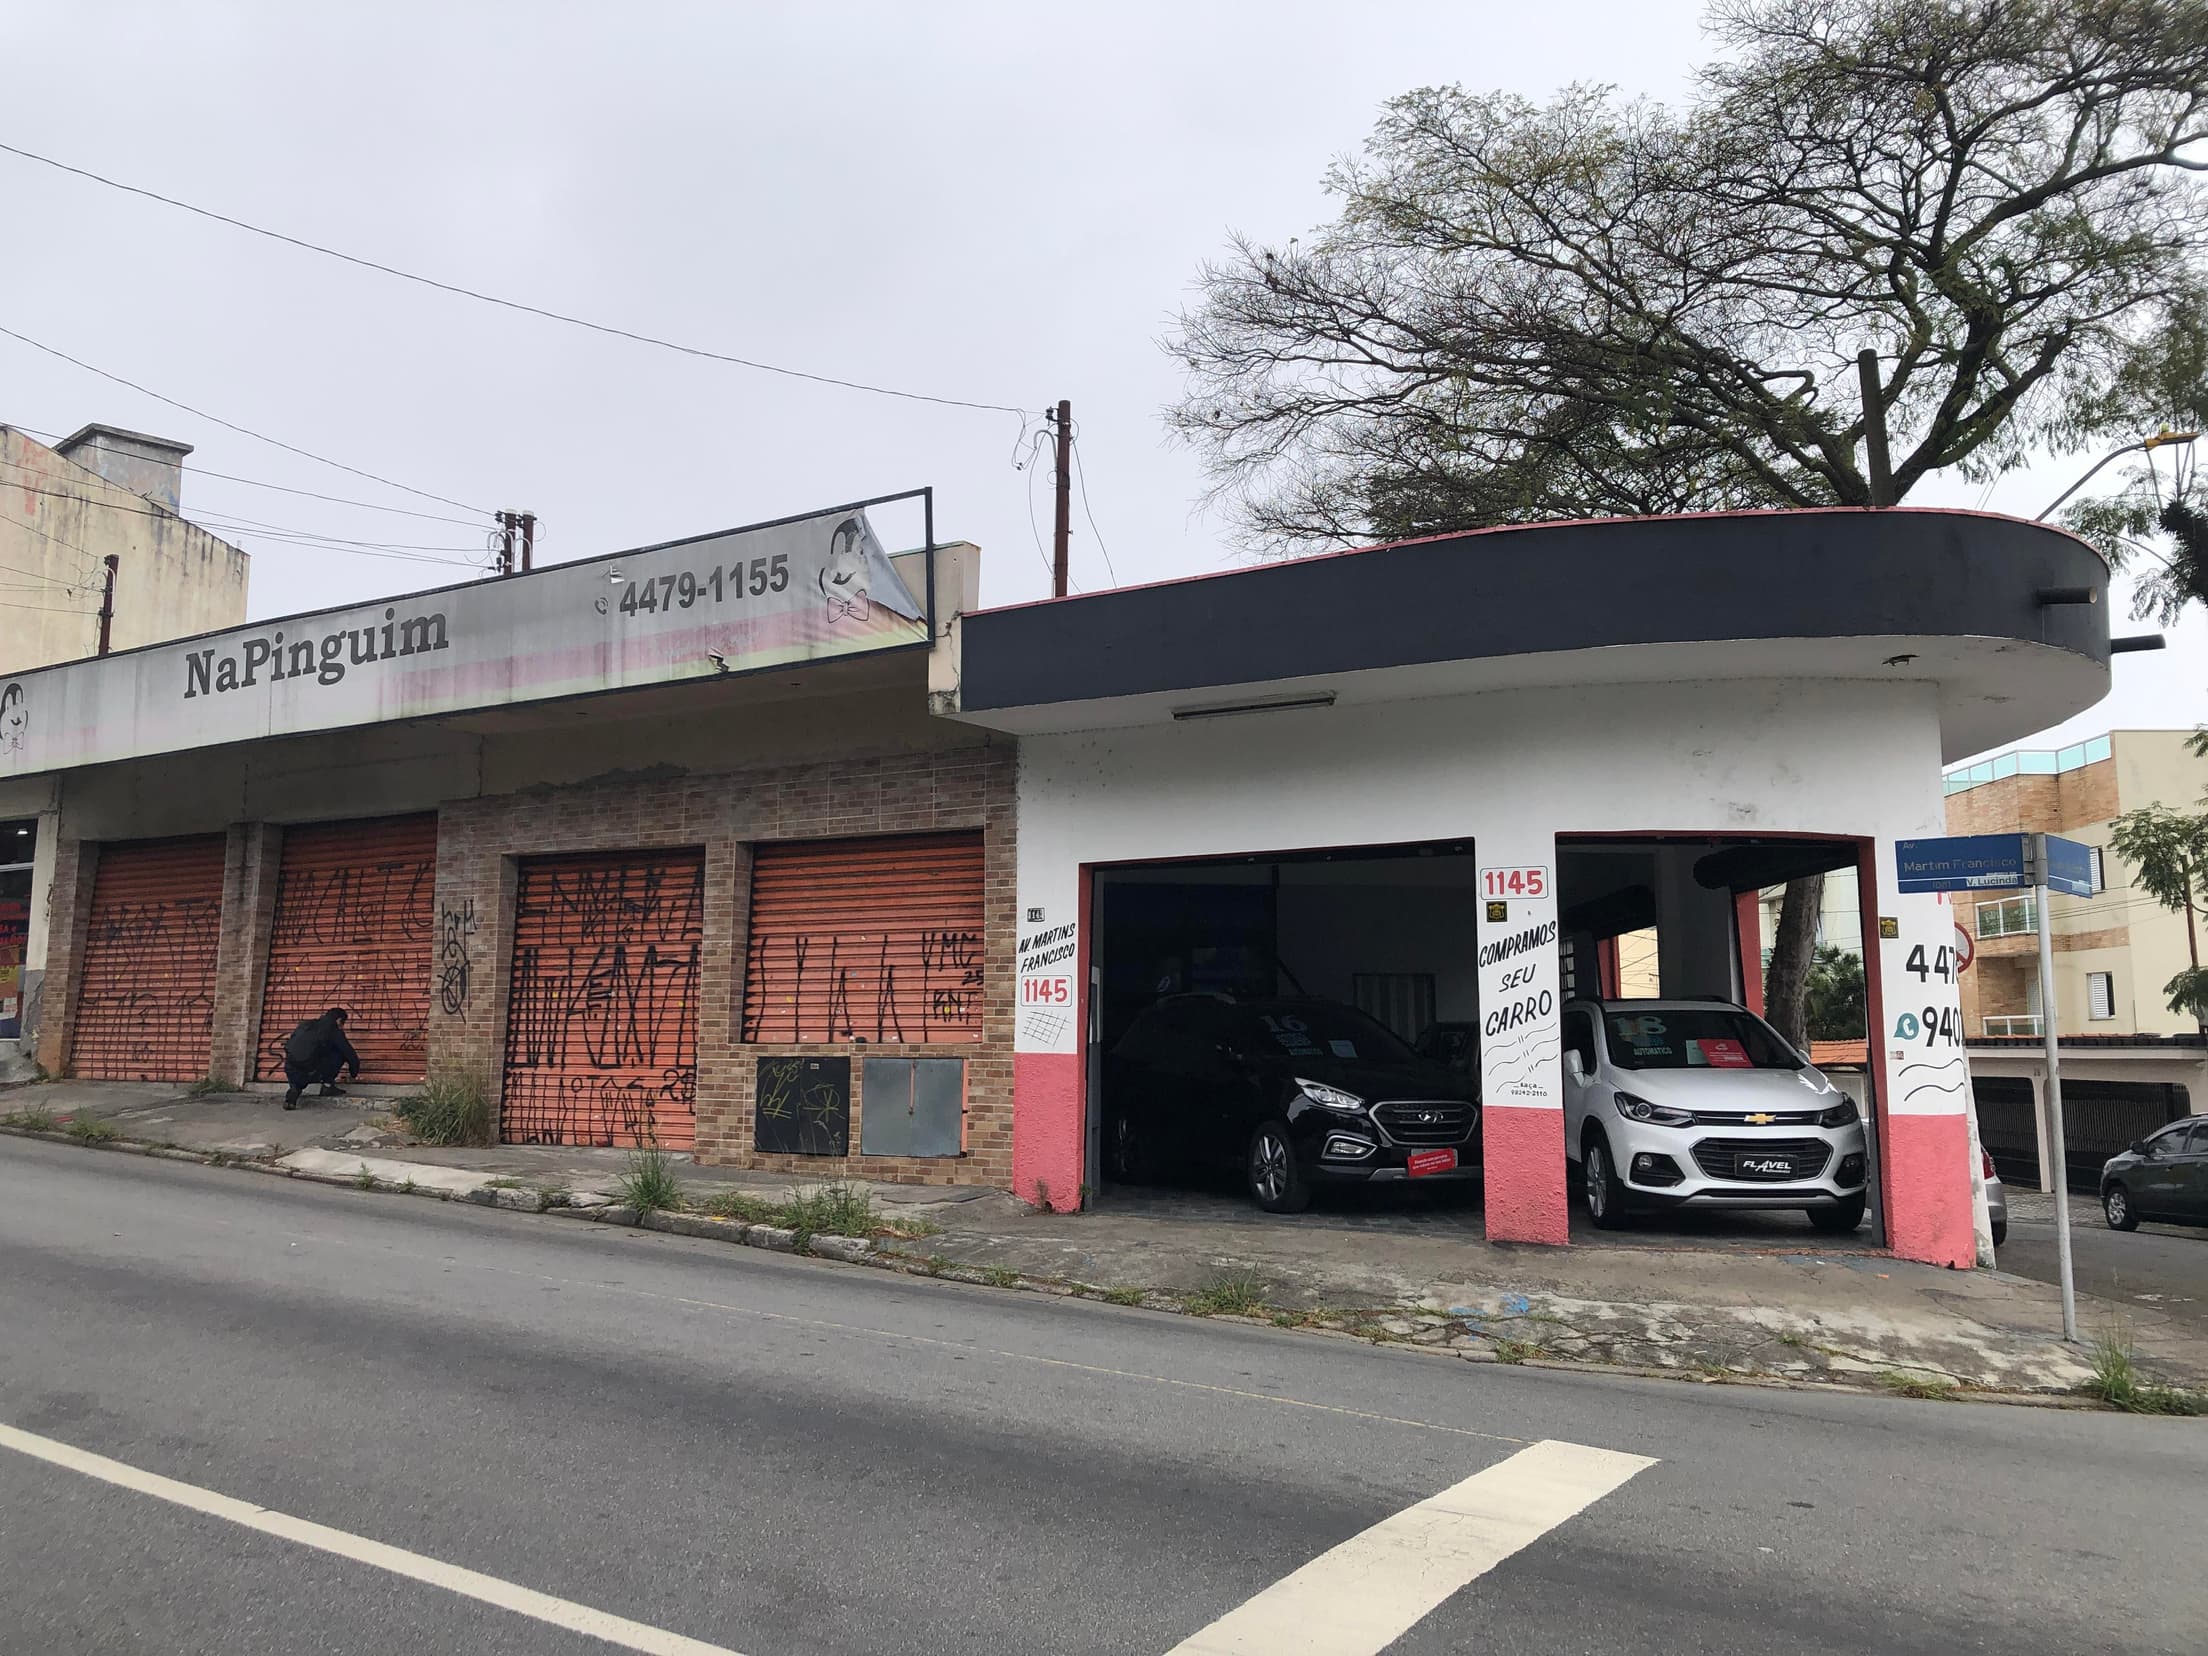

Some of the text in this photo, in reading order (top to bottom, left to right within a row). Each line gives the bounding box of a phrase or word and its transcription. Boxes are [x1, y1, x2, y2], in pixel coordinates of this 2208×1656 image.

[619, 555, 791, 618] 4479-1155
[184, 609, 450, 699] NaPinguim
[1903, 841, 1919, 850] Av.
[1903, 860, 1950, 873] Martim
[1485, 870, 1543, 896] 1145
[1032, 922, 1077, 950] MARTINS
[1479, 921, 1557, 969] COMPRAMOS
[1020, 942, 1076, 974] FRANCISCO
[1024, 978, 1068, 1003] 1145
[1499, 964, 1537, 993] SEU
[1485, 990, 1552, 1037] CARRO
[1921, 1006, 1961, 1048] 940
[1743, 1160, 1793, 1172] FLAVEL
